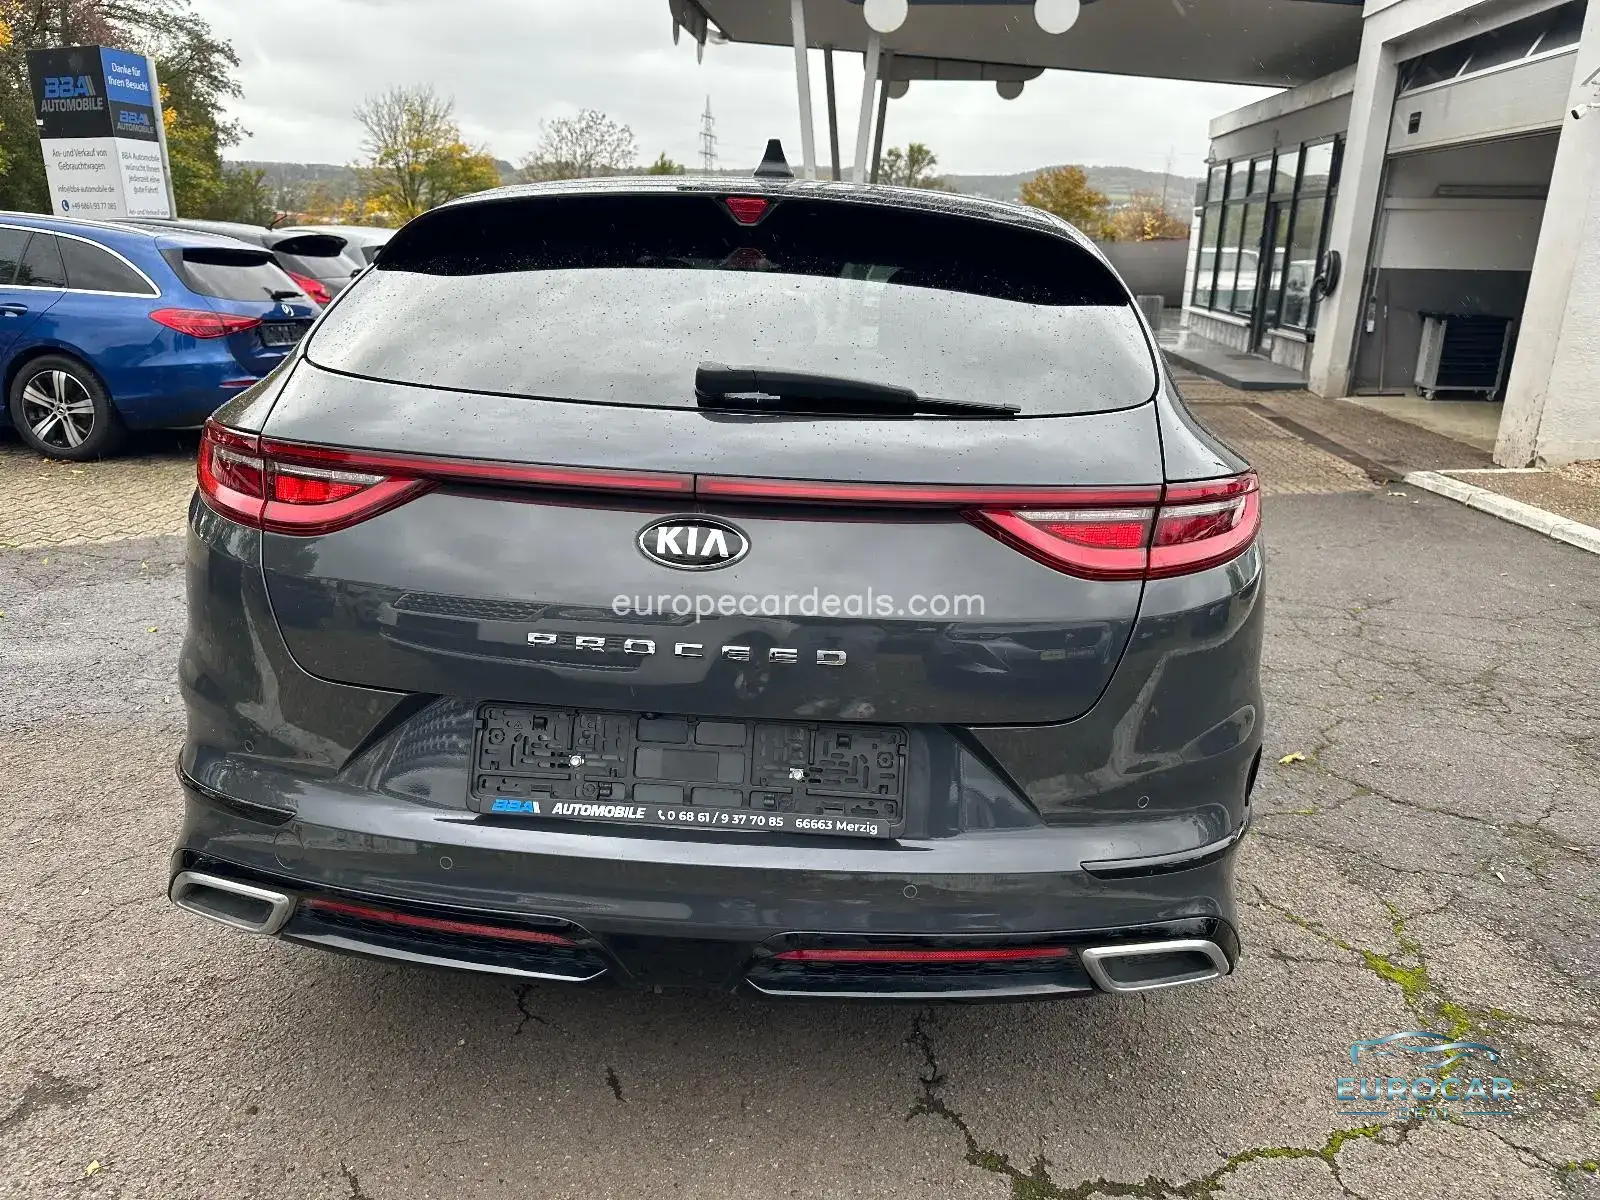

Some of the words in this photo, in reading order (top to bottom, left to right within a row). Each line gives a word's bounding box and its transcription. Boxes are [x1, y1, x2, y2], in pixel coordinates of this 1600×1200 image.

[112, 62, 132, 76] Danke
[132, 66, 141, 76] für
[44, 75, 96, 98] BBA
[107, 75, 125, 88] Ihren
[125, 79, 149, 92] Besuch!
[41, 97, 104, 113] AUTOMOBILE
[117, 122, 154, 134] AUTOMOBILE
[63, 148, 74, 157] und
[74, 147, 95, 157] Verkauf
[97, 149, 108, 157] von
[121, 151, 132, 160] BBA
[132, 152, 160, 162] Automobile
[57, 161, 106, 173] Gebrauchtwagen
[656, 526, 729, 558] KIA
[527, 632, 848, 666] PROCEED
[491, 798, 541, 814] BBA
[552, 802, 647, 819] AUTOMOBILE
[667, 810, 676, 821] 0
[678, 811, 694, 822] 68
[697, 812, 710, 823] 61
[721, 813, 729, 823] 9
[732, 814, 747, 825] 37
[749, 815, 766, 826] 70
[768, 816, 784, 827] 85
[795, 818, 833, 830] 66663
[836, 820, 878, 836] Merzig
